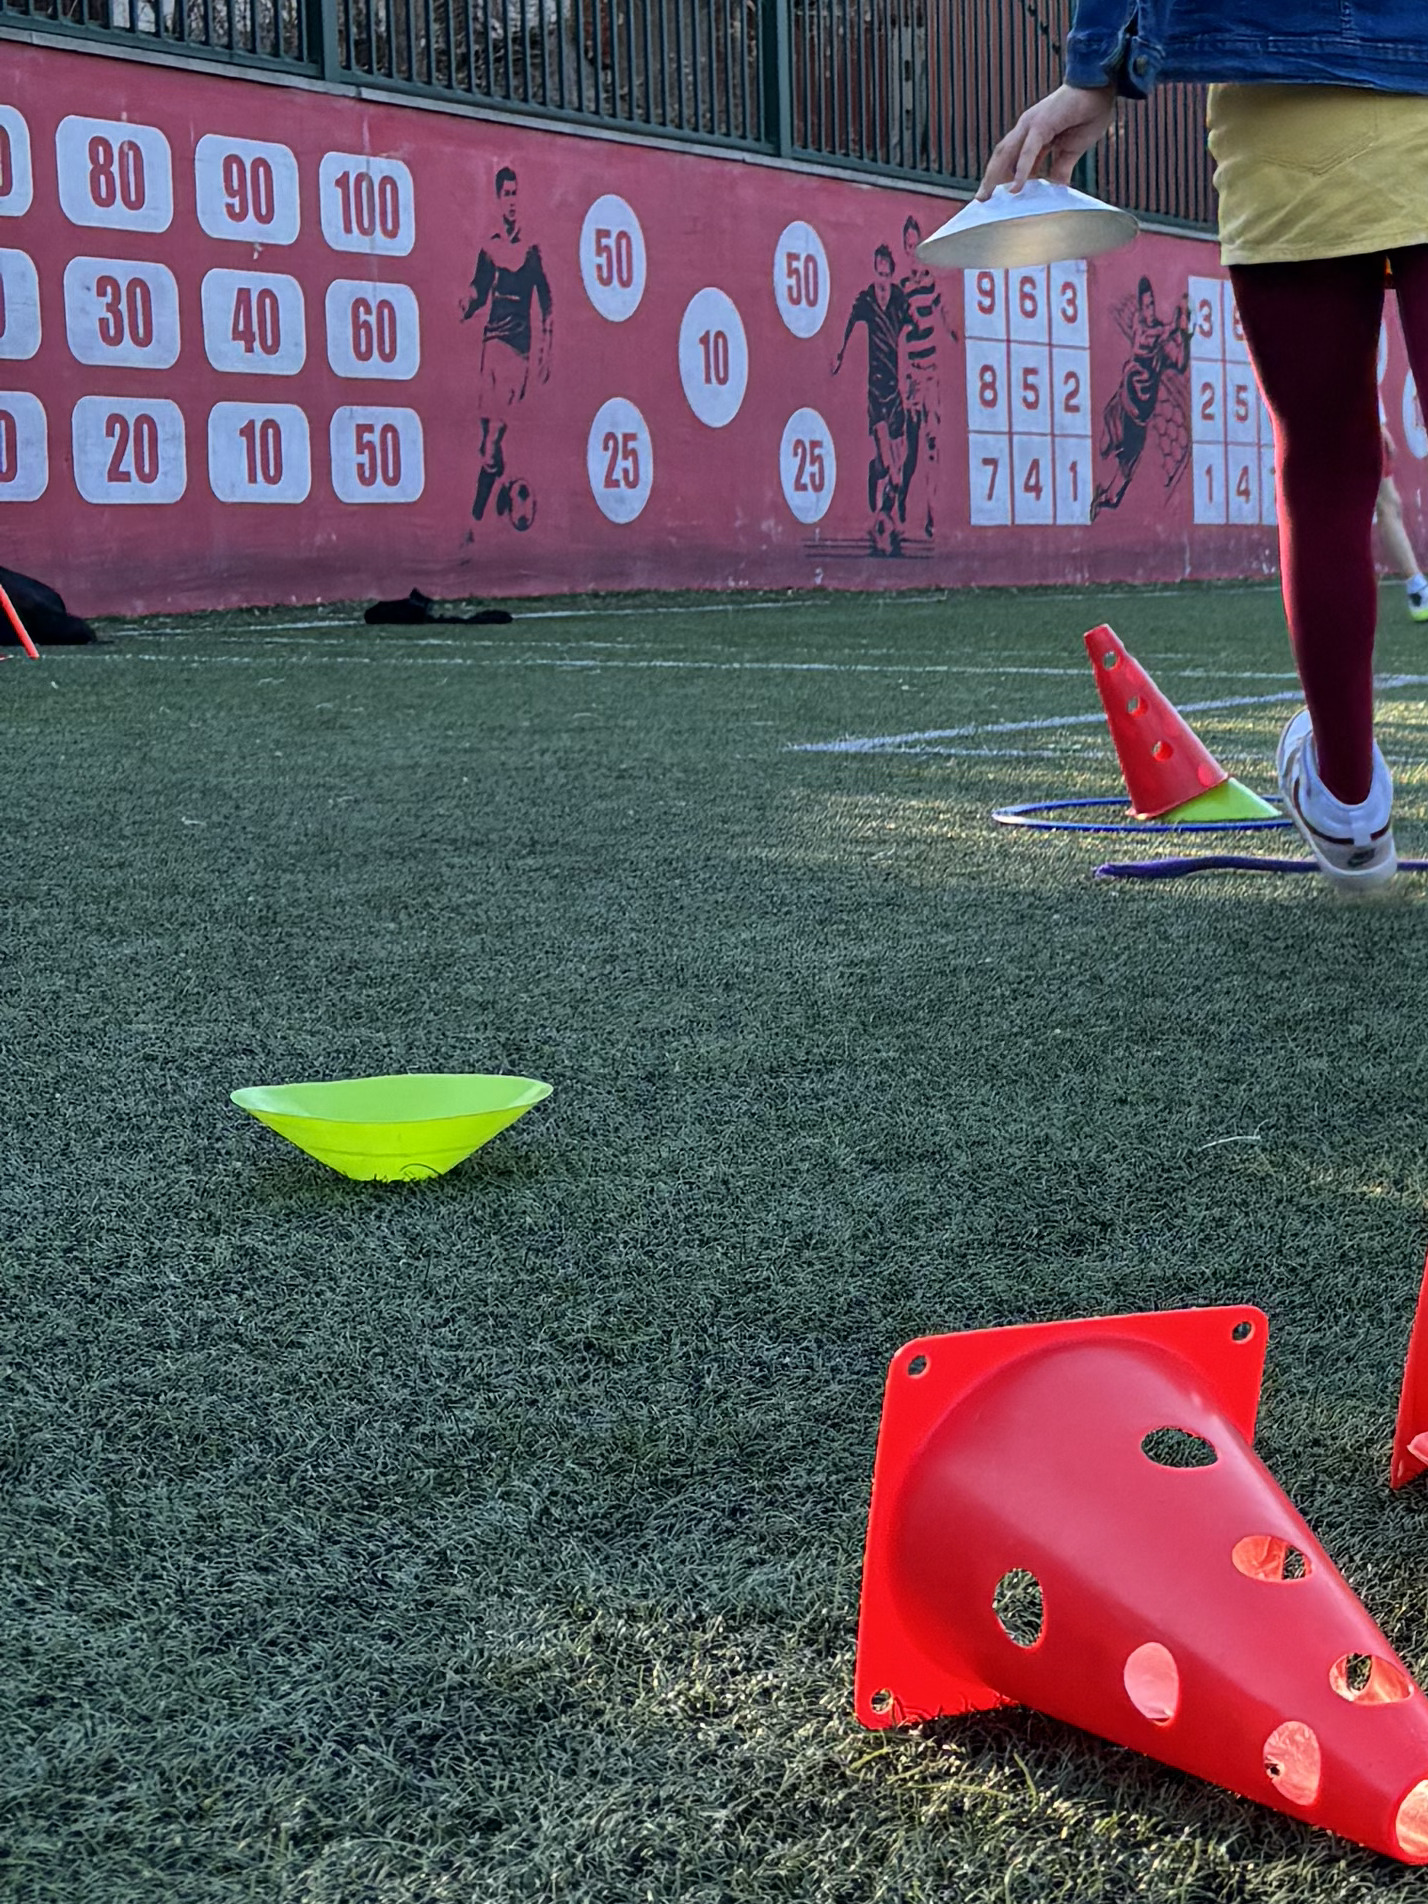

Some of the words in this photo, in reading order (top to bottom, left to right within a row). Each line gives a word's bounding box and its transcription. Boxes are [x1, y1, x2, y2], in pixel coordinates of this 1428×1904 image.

[88, 135, 146, 212] 80
[222, 154, 275, 225] 90
[334, 171, 399, 240] 100
[594, 228, 633, 289] 50
[785, 252, 818, 308] 50
[96, 275, 153, 348] 30
[231, 287, 281, 356] 40
[350, 298, 397, 363] 60
[976, 271, 995, 316] 9
[1018, 275, 1038, 320] 6
[1060, 281, 1079, 324] 3
[1198, 299, 1213, 339] 3
[698, 330, 729, 386] 10
[978, 364, 998, 409] 8
[1021, 367, 1039, 410] 5
[1062, 370, 1081, 413] 2
[1200, 381, 1215, 421] 2
[1234, 384, 1249, 423] 5
[104, 413, 159, 485] 20
[238, 418, 283, 486] 10
[354, 423, 400, 488] 50
[602, 432, 639, 490] 25
[792, 438, 825, 494] 25
[980, 457, 999, 502] 7
[1022, 458, 1043, 501] 4
[1068, 460, 1078, 502] 1
[1204, 464, 1214, 504] 1
[1235, 465, 1251, 504] 4
